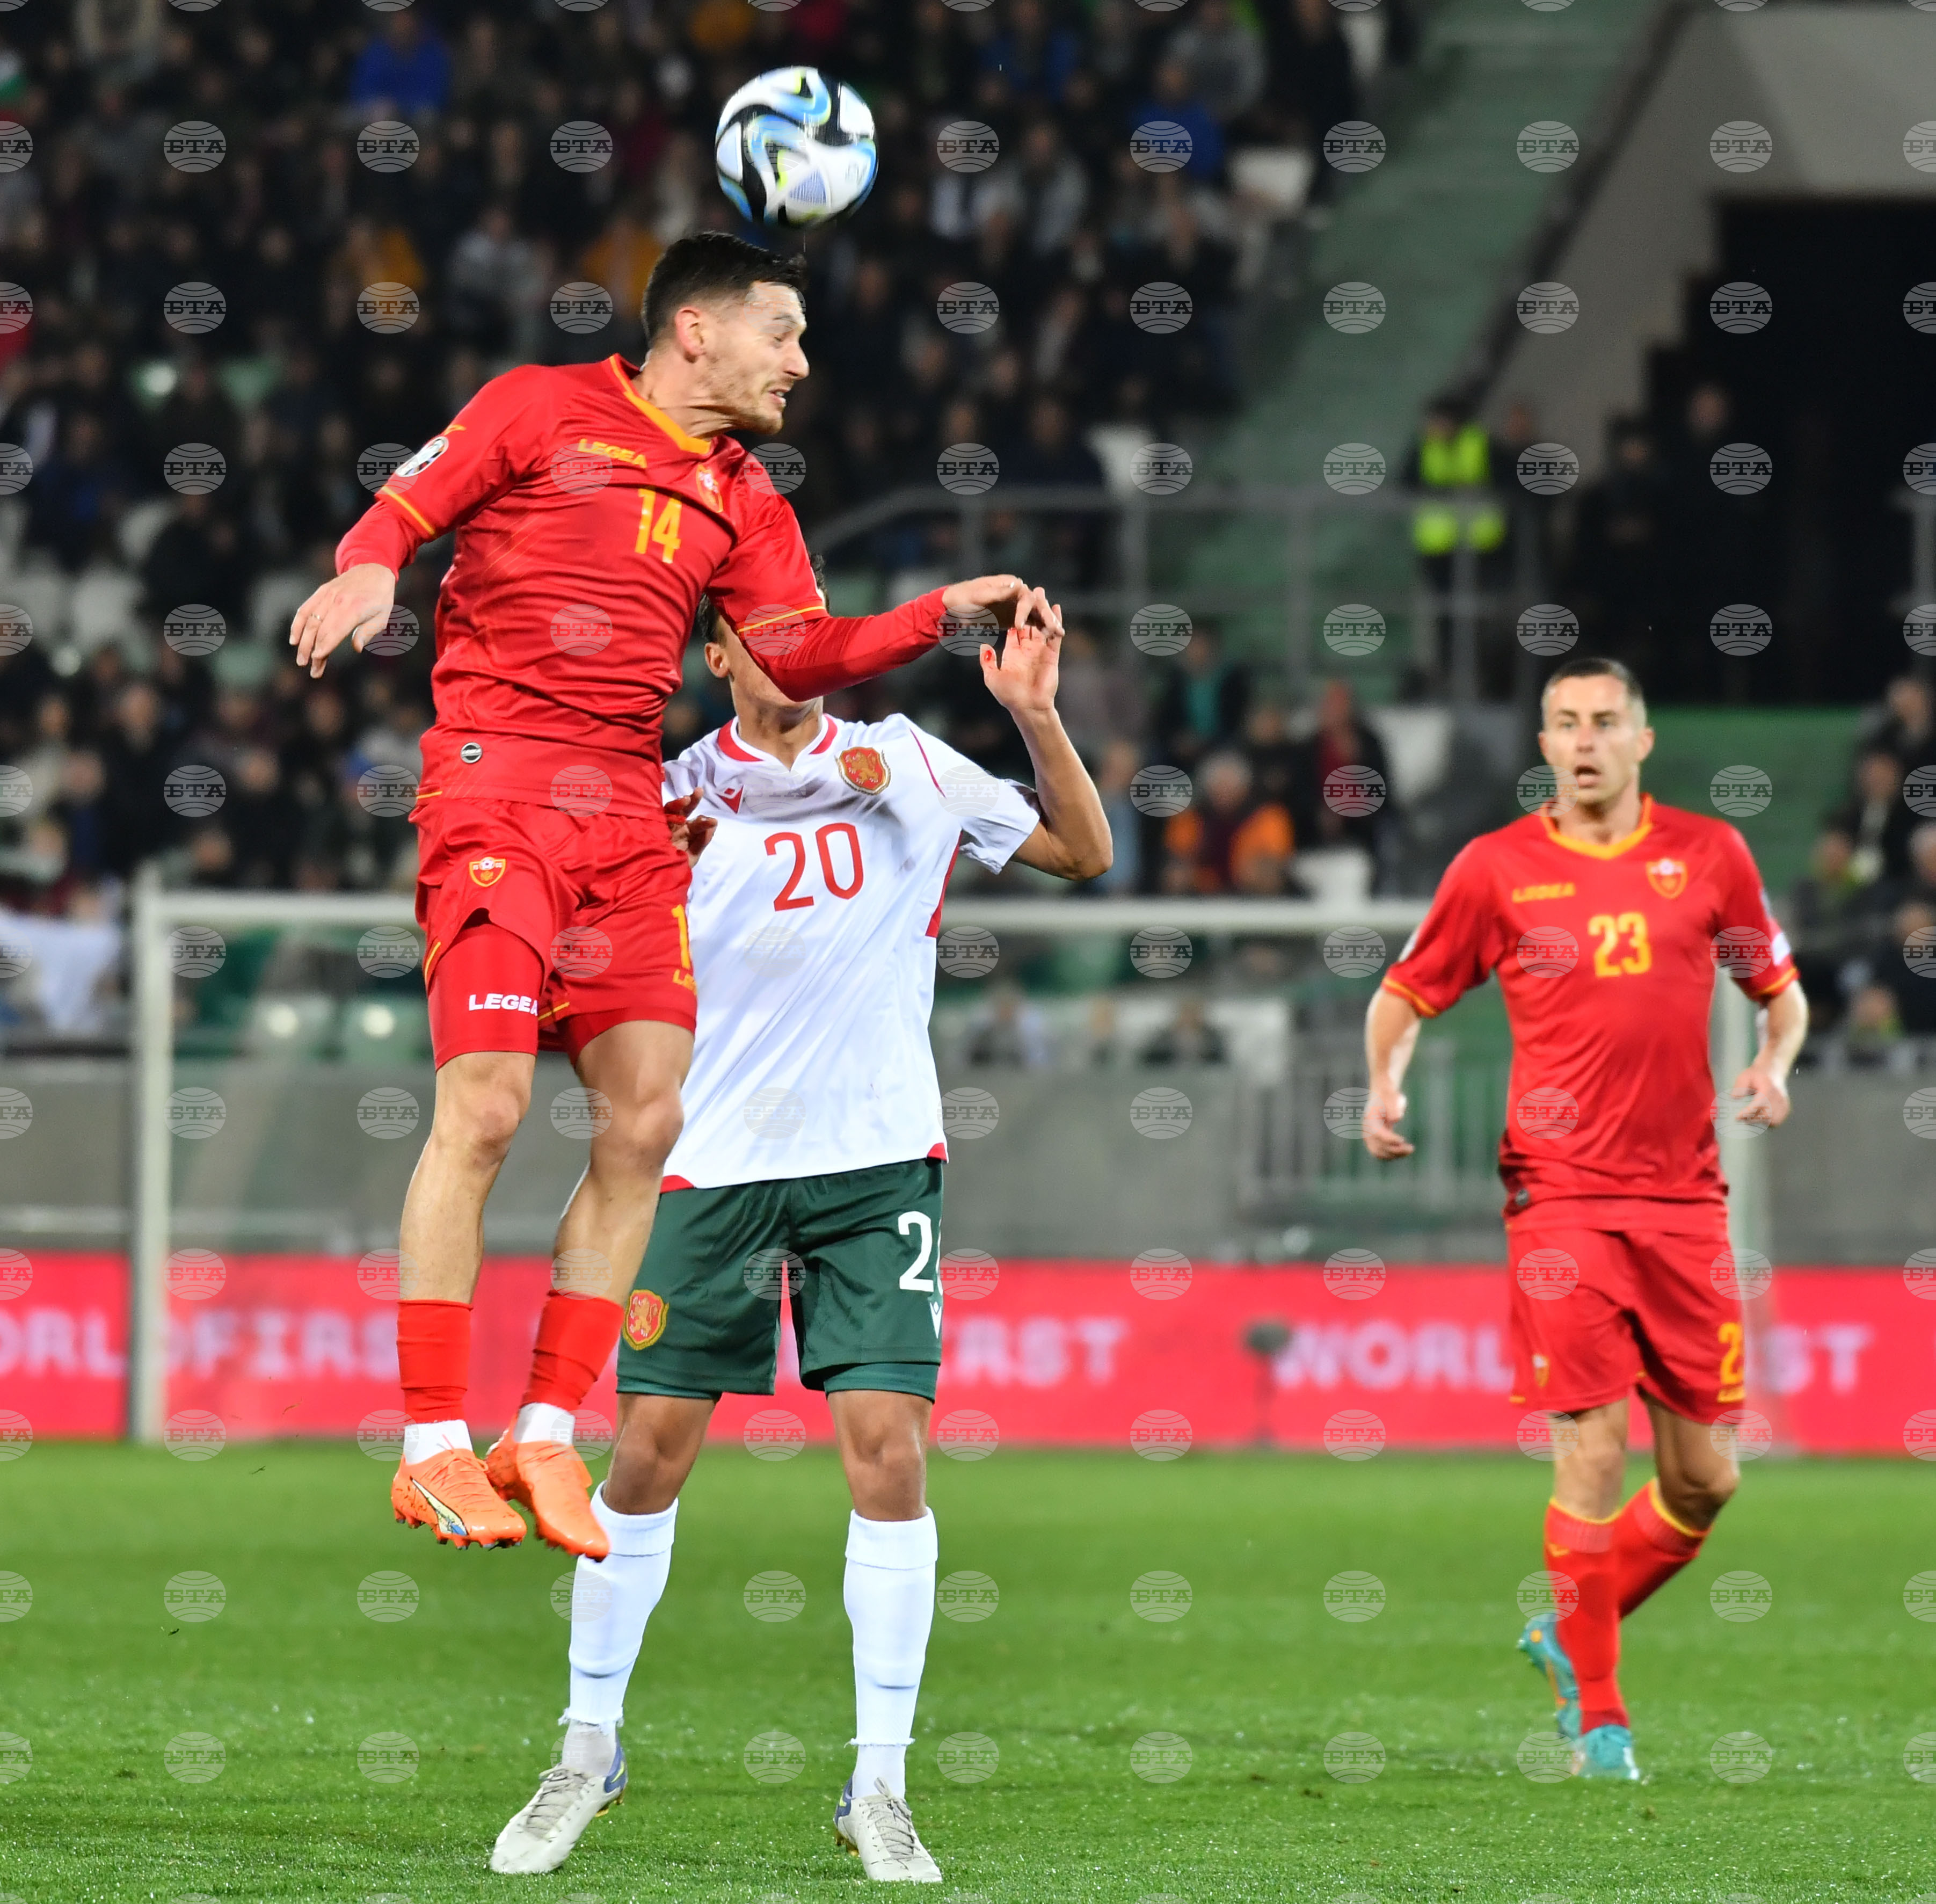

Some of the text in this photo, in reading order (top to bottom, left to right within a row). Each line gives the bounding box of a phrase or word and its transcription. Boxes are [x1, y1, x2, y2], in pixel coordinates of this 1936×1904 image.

[578, 439, 647, 468] LEGEA
[635, 488, 682, 564] 14
[764, 823, 864, 912] 20
[672, 904, 690, 970] 1
[1588, 912, 1651, 977] 23
[898, 1211, 943, 1296] 2
[1717, 1321, 1744, 1384] 2
